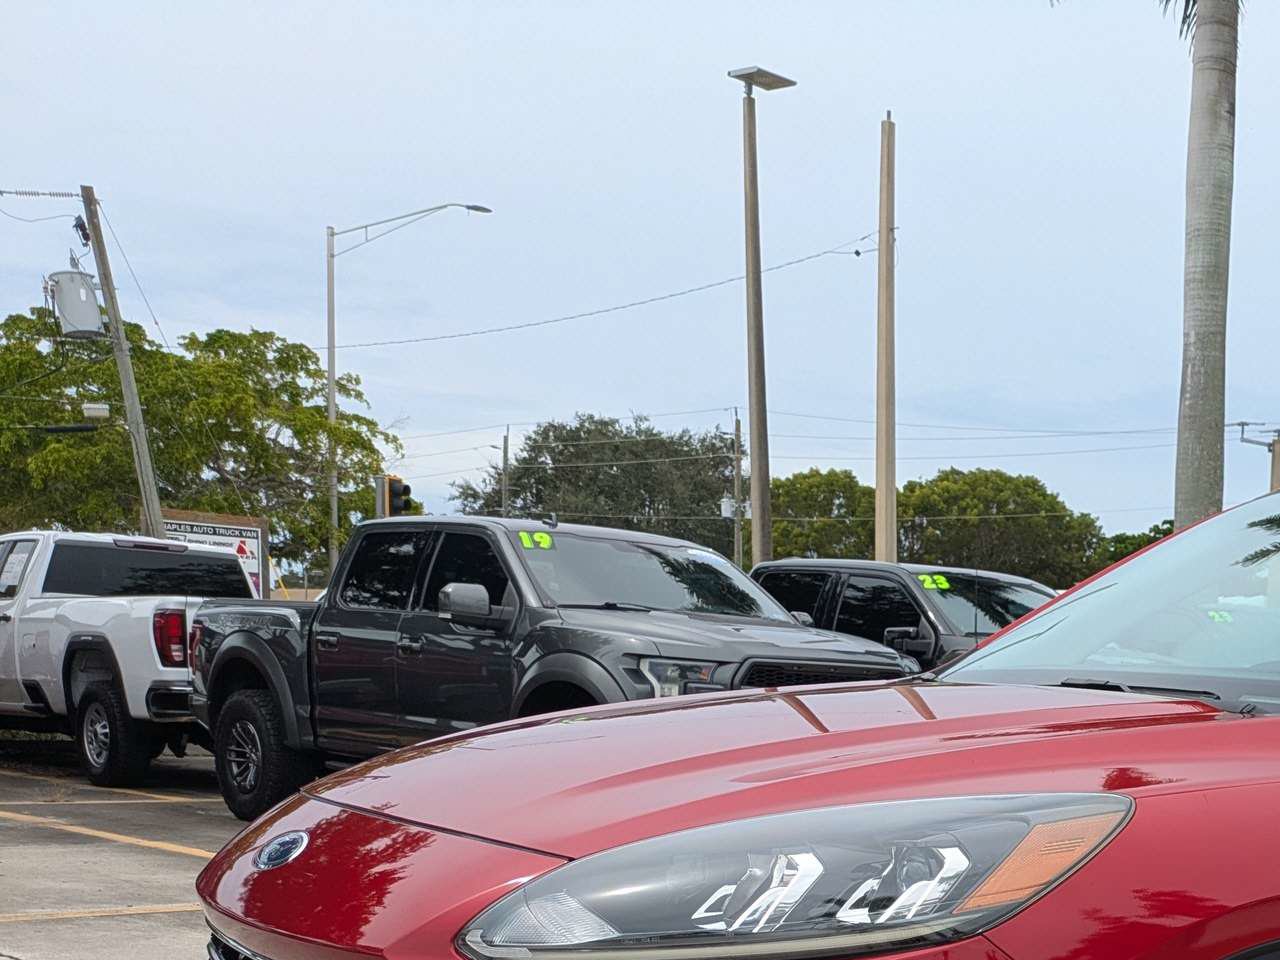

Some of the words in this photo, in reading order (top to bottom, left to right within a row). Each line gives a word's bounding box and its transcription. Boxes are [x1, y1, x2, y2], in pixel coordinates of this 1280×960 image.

[192, 526, 214, 534] AUTO
[215, 528, 240, 537] TRUCK
[242, 530, 257, 538] VAN
[518, 531, 553, 549] 19
[917, 574, 950, 590] 23
